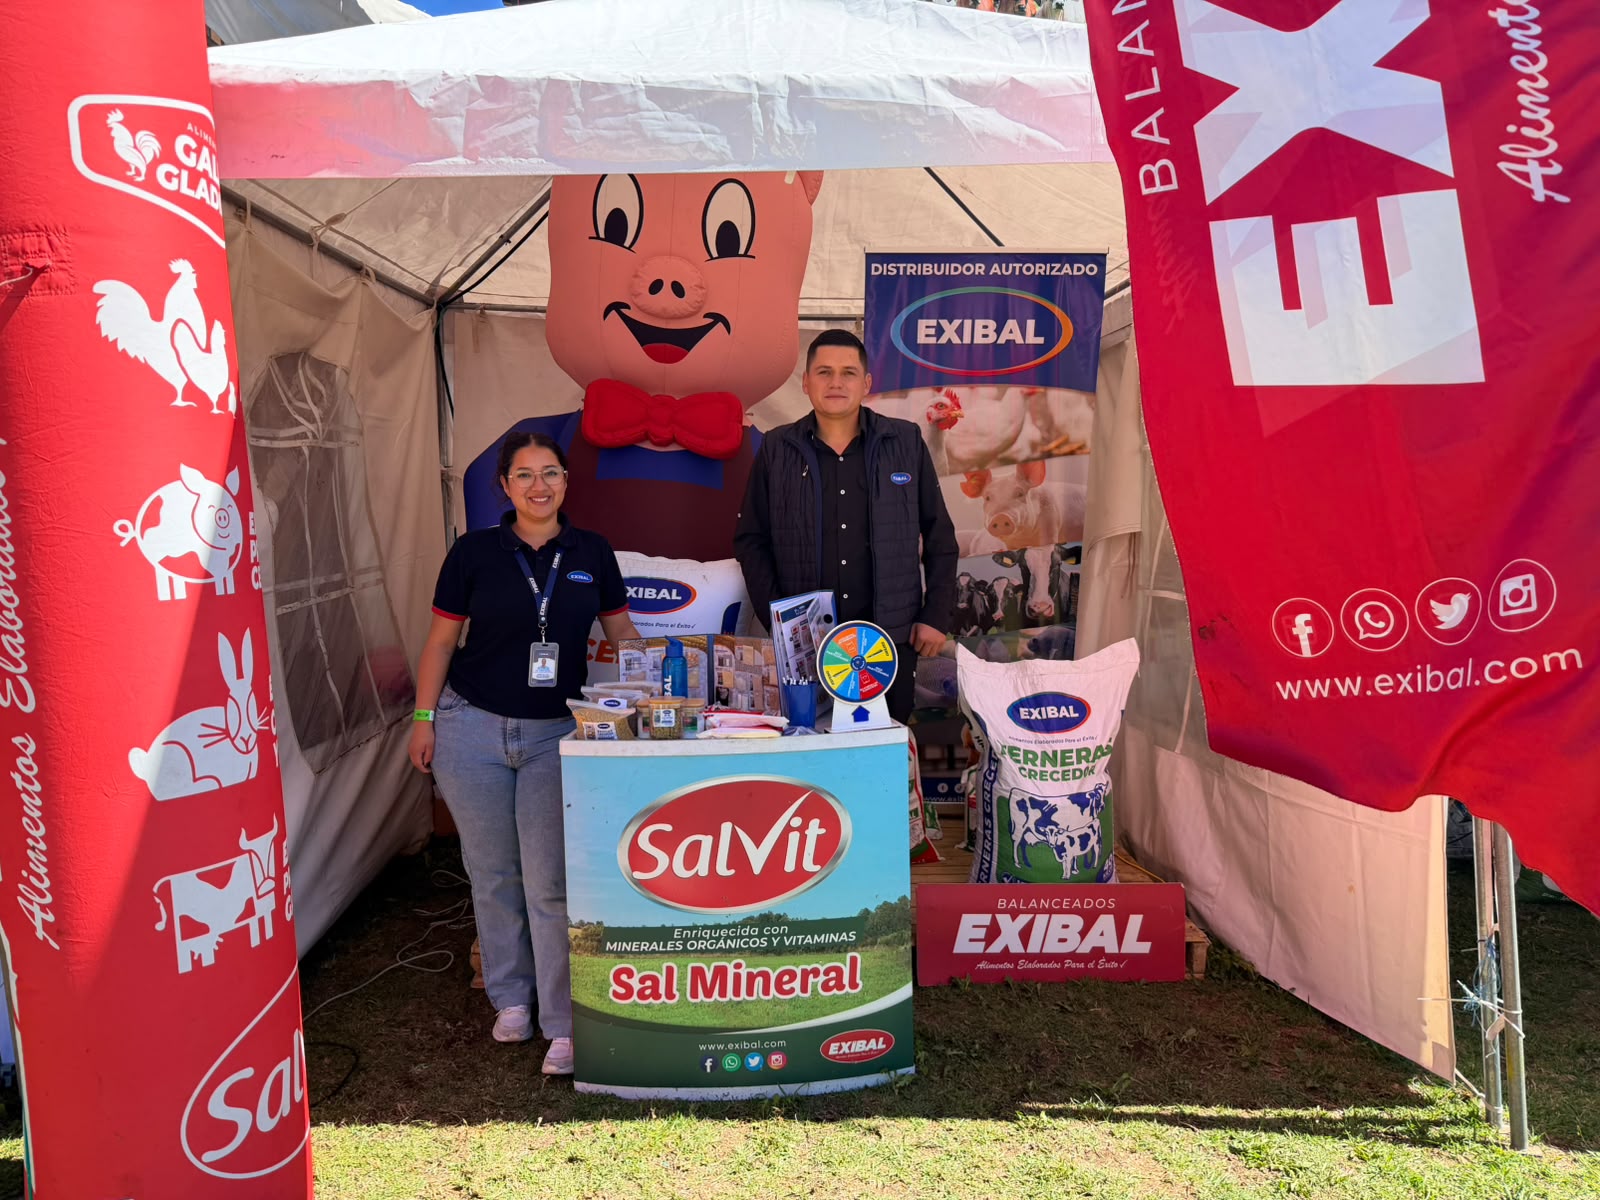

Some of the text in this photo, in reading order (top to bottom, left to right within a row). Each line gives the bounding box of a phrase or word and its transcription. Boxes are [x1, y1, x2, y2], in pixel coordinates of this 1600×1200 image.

[1488, 0, 1571, 203] Aliment
[174, 133, 219, 187] GAL
[155, 163, 222, 215] GLAD
[870, 262, 1098, 277] DISTRIBUIDOR AUTORIZADO
[916, 318, 1045, 345] EXIBAL
[625, 585, 683, 601] XIBAL
[1275, 647, 1584, 701] www.exibal.com
[1019, 704, 1079, 720] EXIBAL
[16, 732, 61, 951] Alimentos
[977, 818, 993, 883] RNERAS
[997, 897, 1116, 910] BALANCEADOS
[605, 931, 857, 952] MINERALES ORGÁNICOS Y VITAMINAS
[673, 926, 789, 941] Enriquecida con
[952, 913, 1153, 954] EXIBAL
[975, 959, 1014, 970] Alimentos
[1017, 959, 1061, 970] Elaborados
[1063, 959, 1084, 969] Para
[1087, 959, 1095, 969] el
[609, 952, 863, 1005] Sal Mineral
[698, 1039, 787, 1051] www.exibal.com
[828, 1036, 887, 1056] EXIBAL
